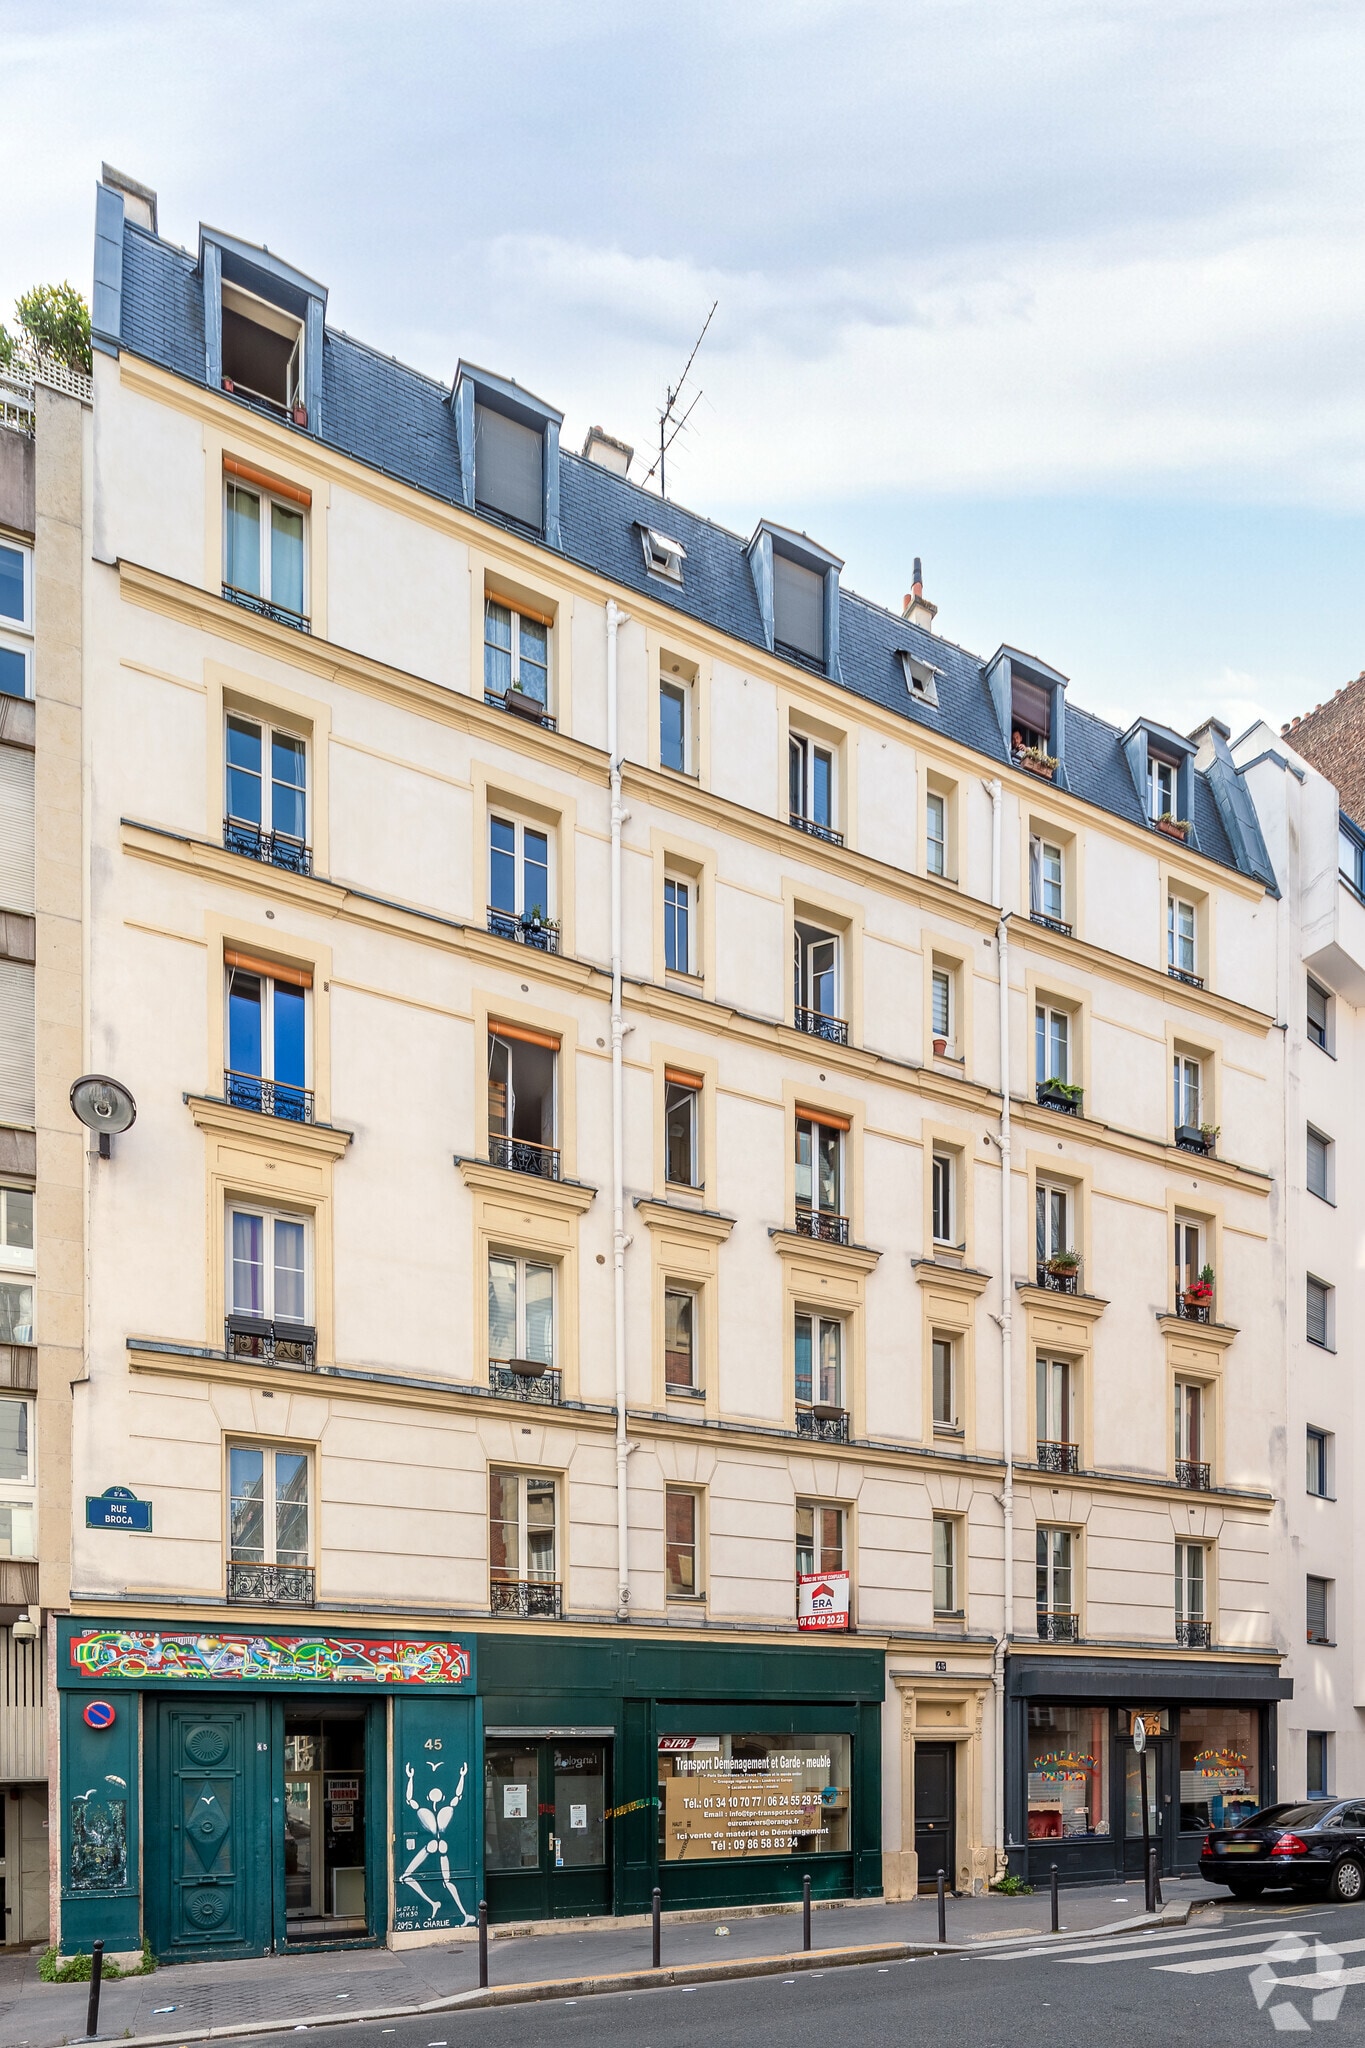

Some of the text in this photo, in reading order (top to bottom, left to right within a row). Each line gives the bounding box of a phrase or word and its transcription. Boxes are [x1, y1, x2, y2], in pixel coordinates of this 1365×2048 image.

[110, 1504, 127, 1513] RUE
[104, 1515, 133, 1525] BROCA
[812, 1599, 832, 1608] ERA
[800, 1617, 807, 1626] 01
[807, 1616, 816, 1625] 40
[817, 1615, 826, 1625] 40
[827, 1615, 835, 1624] 20
[836, 1614, 845, 1623] 23
[936, 1662, 946, 1670] 45
[424, 1739, 443, 1750] 45
[670, 1739, 690, 1748] TPR
[675, 1756, 712, 1773] Transport
[714, 1755, 769, 1773] Déménagement
[771, 1756, 778, 1769] et
[780, 1755, 800, 1769] Garde
[806, 1755, 831, 1768] meuble
[704, 1797, 713, 1808] 01
[716, 1797, 726, 1808] 34
[728, 1797, 738, 1807] 10
[740, 1797, 750, 1807] 70
[752, 1796, 762, 1806] 77
[767, 1796, 777, 1806] 06
[779, 1795, 789, 1806] 24
[790, 1795, 800, 1806] 55
[802, 1795, 811, 1805] 29
[813, 1794, 822, 1805] 25
[729, 1808, 804, 1818] info@tpr-transport.com
[727, 1817, 800, 1827] euromovers@orange.fr
[726, 1829, 758, 1838] matériel
[771, 1827, 829, 1836] Déménagement
[711, 1840, 726, 1851] Tél
[734, 1840, 745, 1850] 09
[747, 1839, 758, 1849] 86
[761, 1838, 772, 1848] 58
[774, 1838, 785, 1848] 83
[787, 1837, 798, 1847] 24
[396, 1921, 414, 1931] 2015
[423, 1920, 450, 1928] CHARLIE
